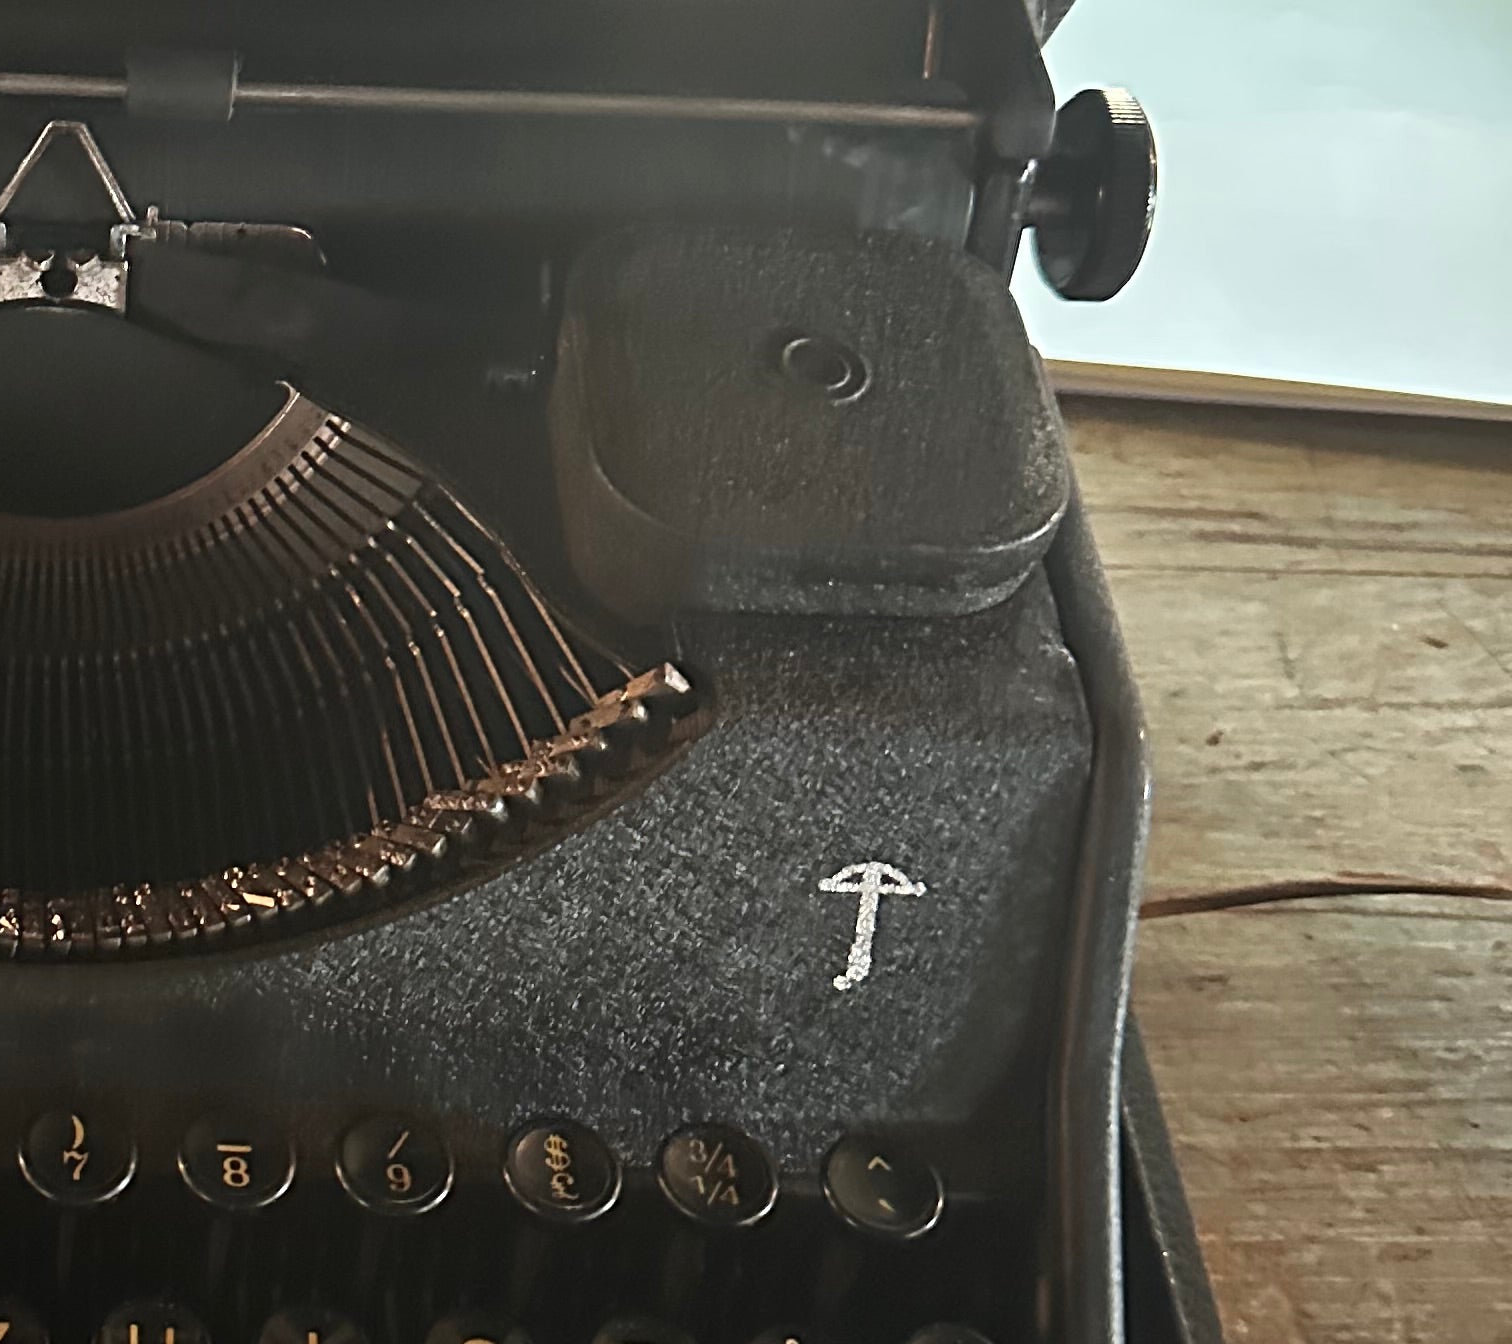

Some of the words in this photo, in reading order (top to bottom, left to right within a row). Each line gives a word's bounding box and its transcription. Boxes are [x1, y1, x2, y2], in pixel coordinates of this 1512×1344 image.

[72, 1114, 84, 1148] )
[389, 1132, 408, 1158] /
[64, 1151, 87, 1180] 7
[544, 1135, 568, 1171] $
[224, 1157, 249, 1186] 8
[387, 1165, 410, 1191] 9
